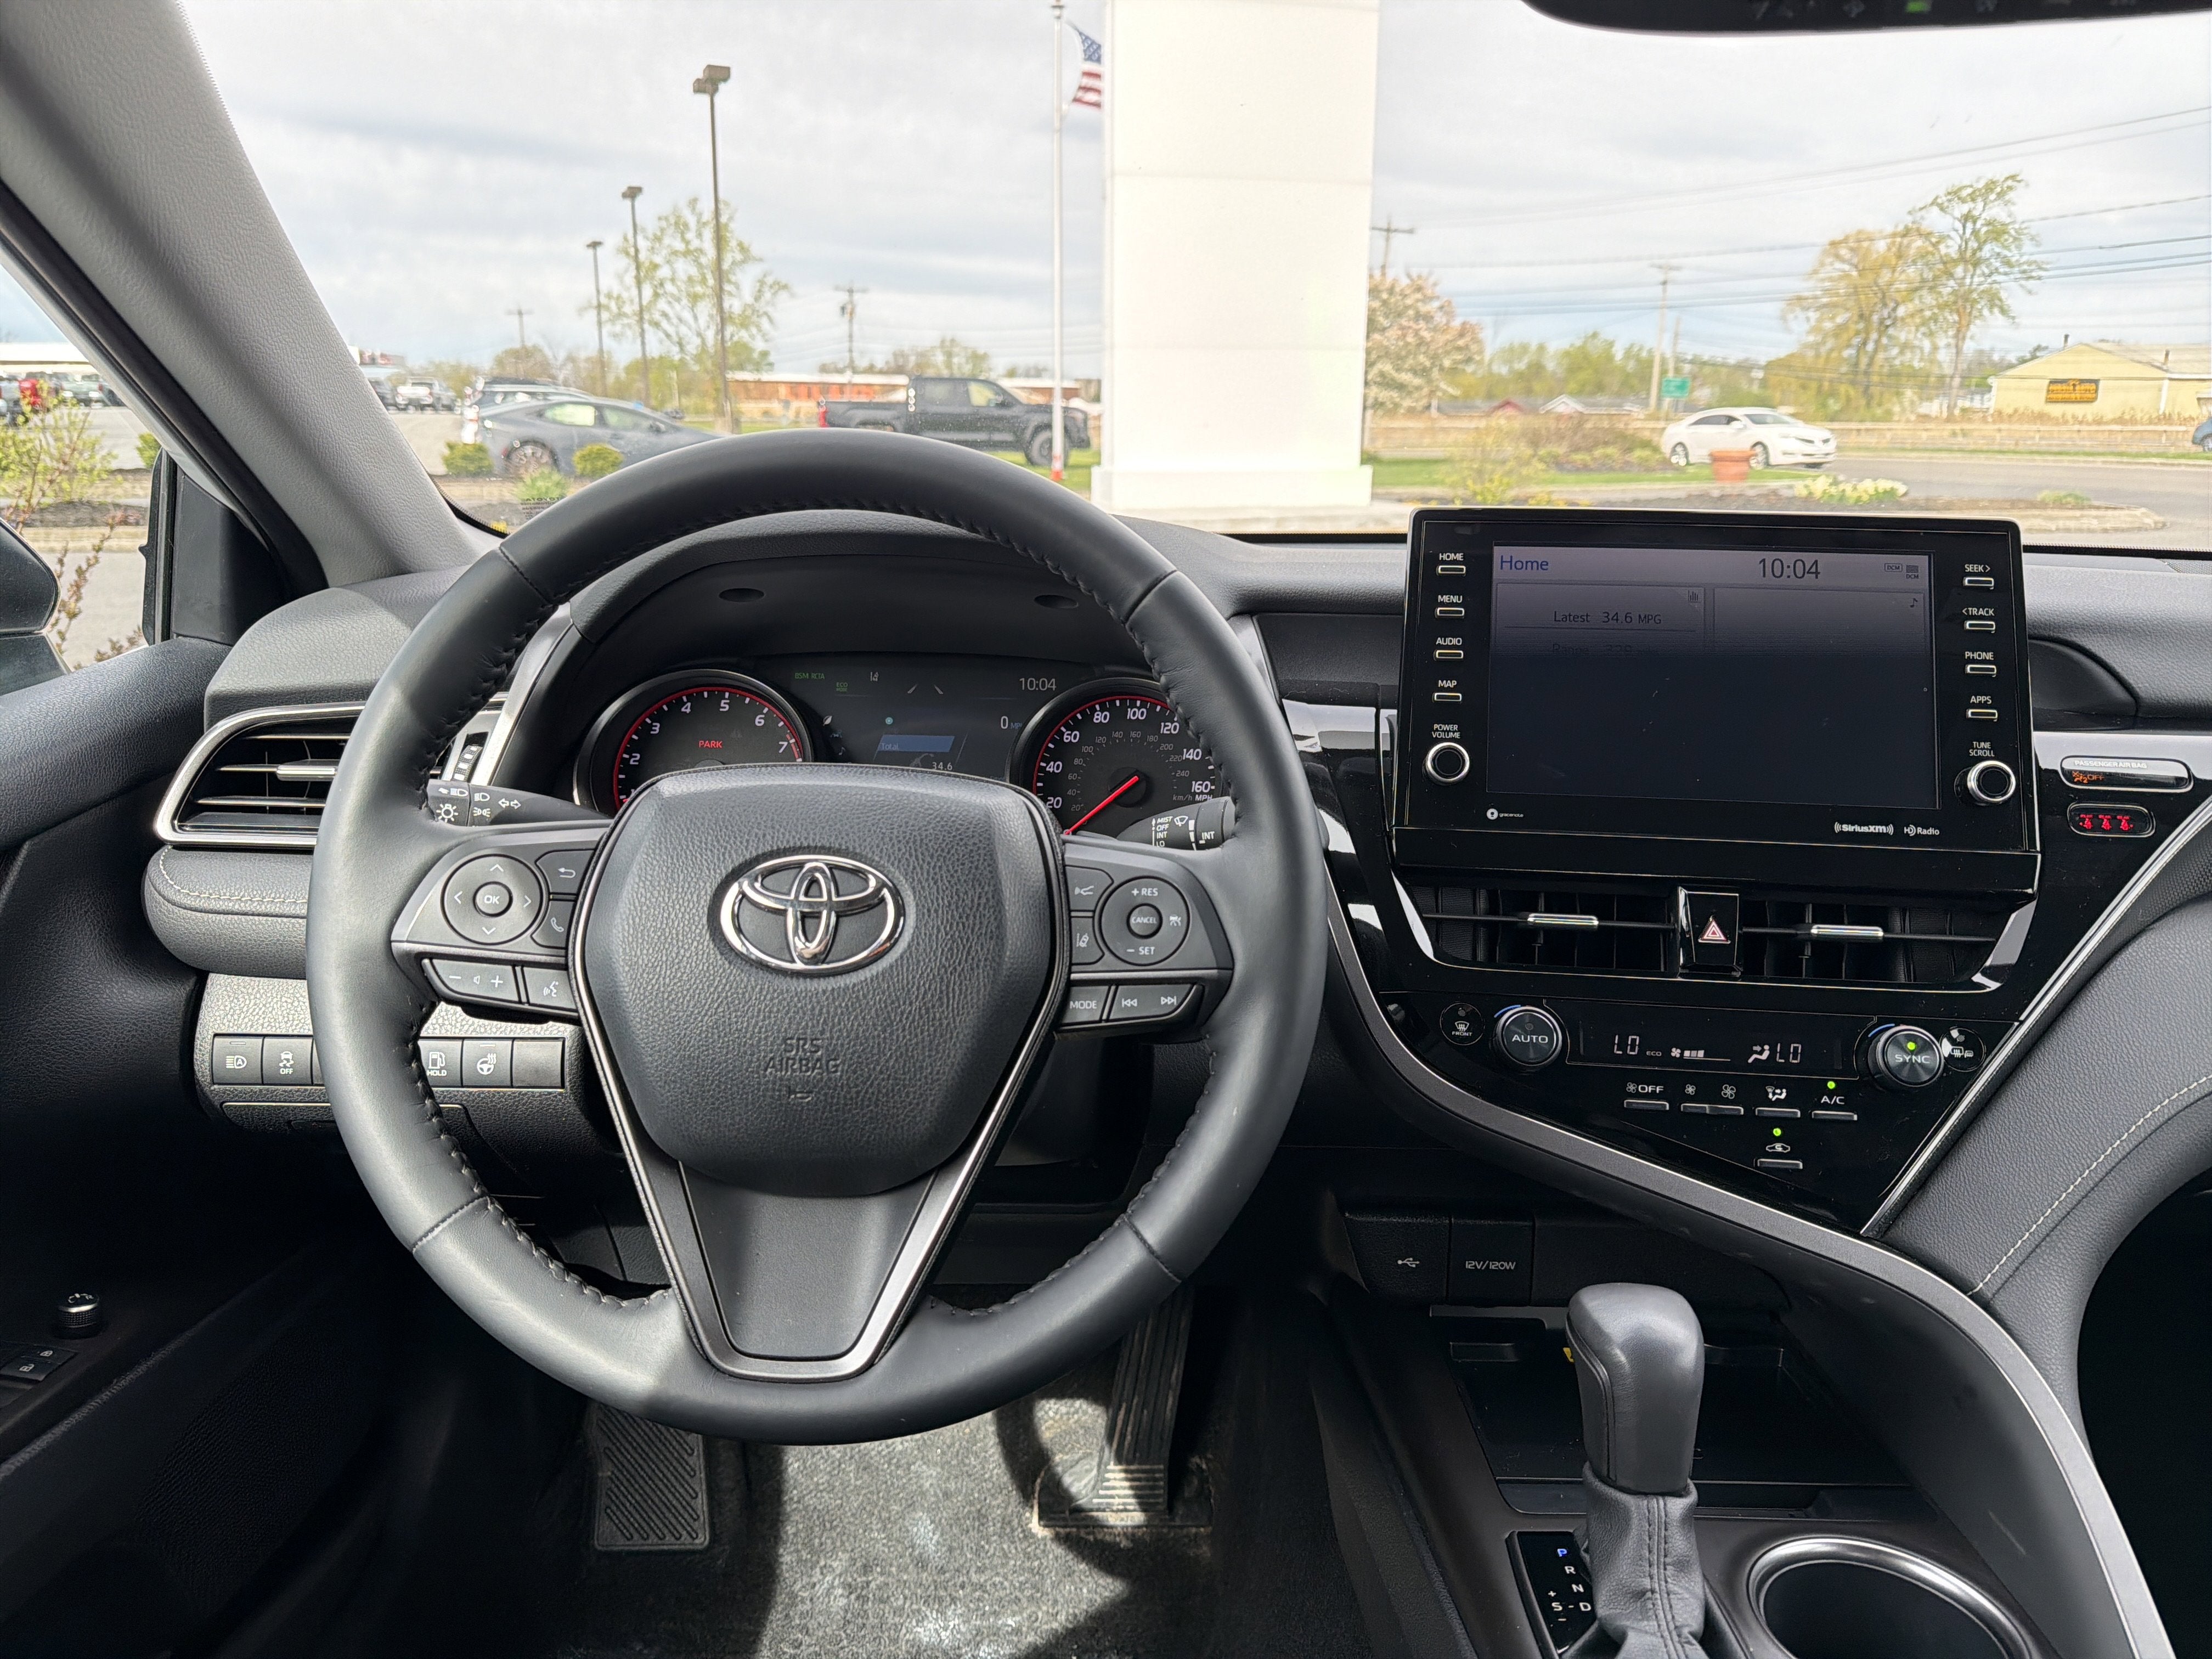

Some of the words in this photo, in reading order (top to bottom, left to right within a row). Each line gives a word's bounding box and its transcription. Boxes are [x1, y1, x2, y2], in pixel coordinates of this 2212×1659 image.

[1500, 556, 1549, 571] Home
[1759, 558, 1820, 579] 10:04
[1554, 611, 1590, 623] Latest
[1602, 612, 1633, 624] 34.6
[1638, 614, 1662, 624] MPG
[1965, 652, 1994, 660] PHONE
[1019, 678, 1057, 691] 10:04
[1970, 696, 1991, 704] APPS
[681, 702, 692, 714] 4
[720, 700, 730, 712] 5
[1093, 712, 1110, 723] 80
[1127, 708, 1147, 720] 100
[755, 715, 765, 726] 6
[1001, 715, 1008, 729] 0
[650, 723, 661, 734] 3
[1160, 722, 1180, 734] 120
[1063, 731, 1080, 743] 60
[698, 740, 723, 748] PARK
[778, 741, 788, 753] 7
[630, 753, 640, 765] 2
[1183, 748, 1202, 760] 140
[932, 762, 953, 771] 34.6
[1046, 761, 1063, 773] 40
[1191, 781, 1211, 792] 160
[1046, 797, 1062, 809] 20
[1156, 816, 1173, 824] MIST
[1156, 823, 1170, 832] OFF
[1201, 831, 1215, 839] INT
[1141, 888, 1159, 896] RES
[484, 895, 500, 905] OK
[1138, 946, 1155, 955] SET
[1070, 1001, 1097, 1009] MODE
[1511, 1035, 1548, 1043] AUTO
[1614, 1034, 1640, 1054] LO
[1776, 1043, 1801, 1063] LO
[1895, 1054, 1930, 1064] SYNC
[1639, 1085, 1664, 1093] OFF
[1821, 1096, 1844, 1104] A/C
[1465, 1261, 1516, 1270] 12V/120W
[1558, 1549, 1567, 1557] P
[1565, 1566, 1576, 1575] R
[1572, 1584, 1584, 1593] N
[1579, 1602, 1592, 1611] D
